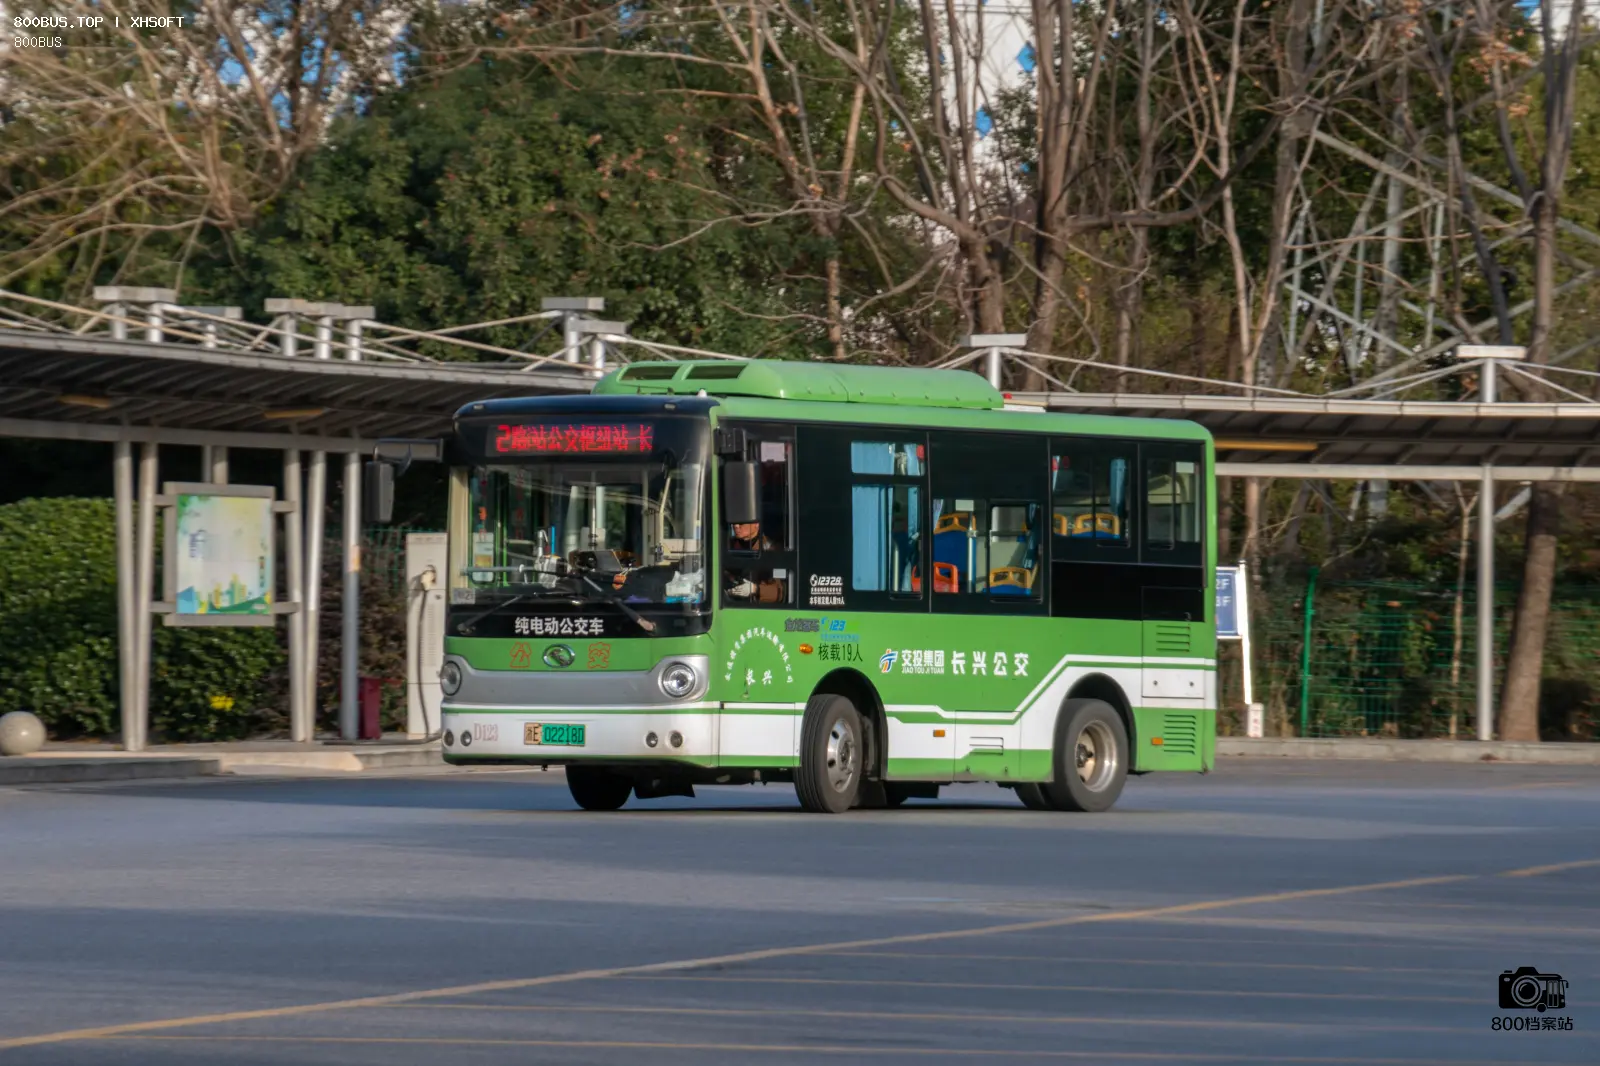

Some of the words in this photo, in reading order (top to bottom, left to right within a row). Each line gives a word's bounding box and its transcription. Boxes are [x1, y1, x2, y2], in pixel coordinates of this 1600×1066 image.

[514, 617, 604, 635] 纯电动公交车
[818, 643, 864, 662] 核载19人
[901, 649, 945, 667] 交投集团
[951, 650, 1029, 676] 长兴公交
